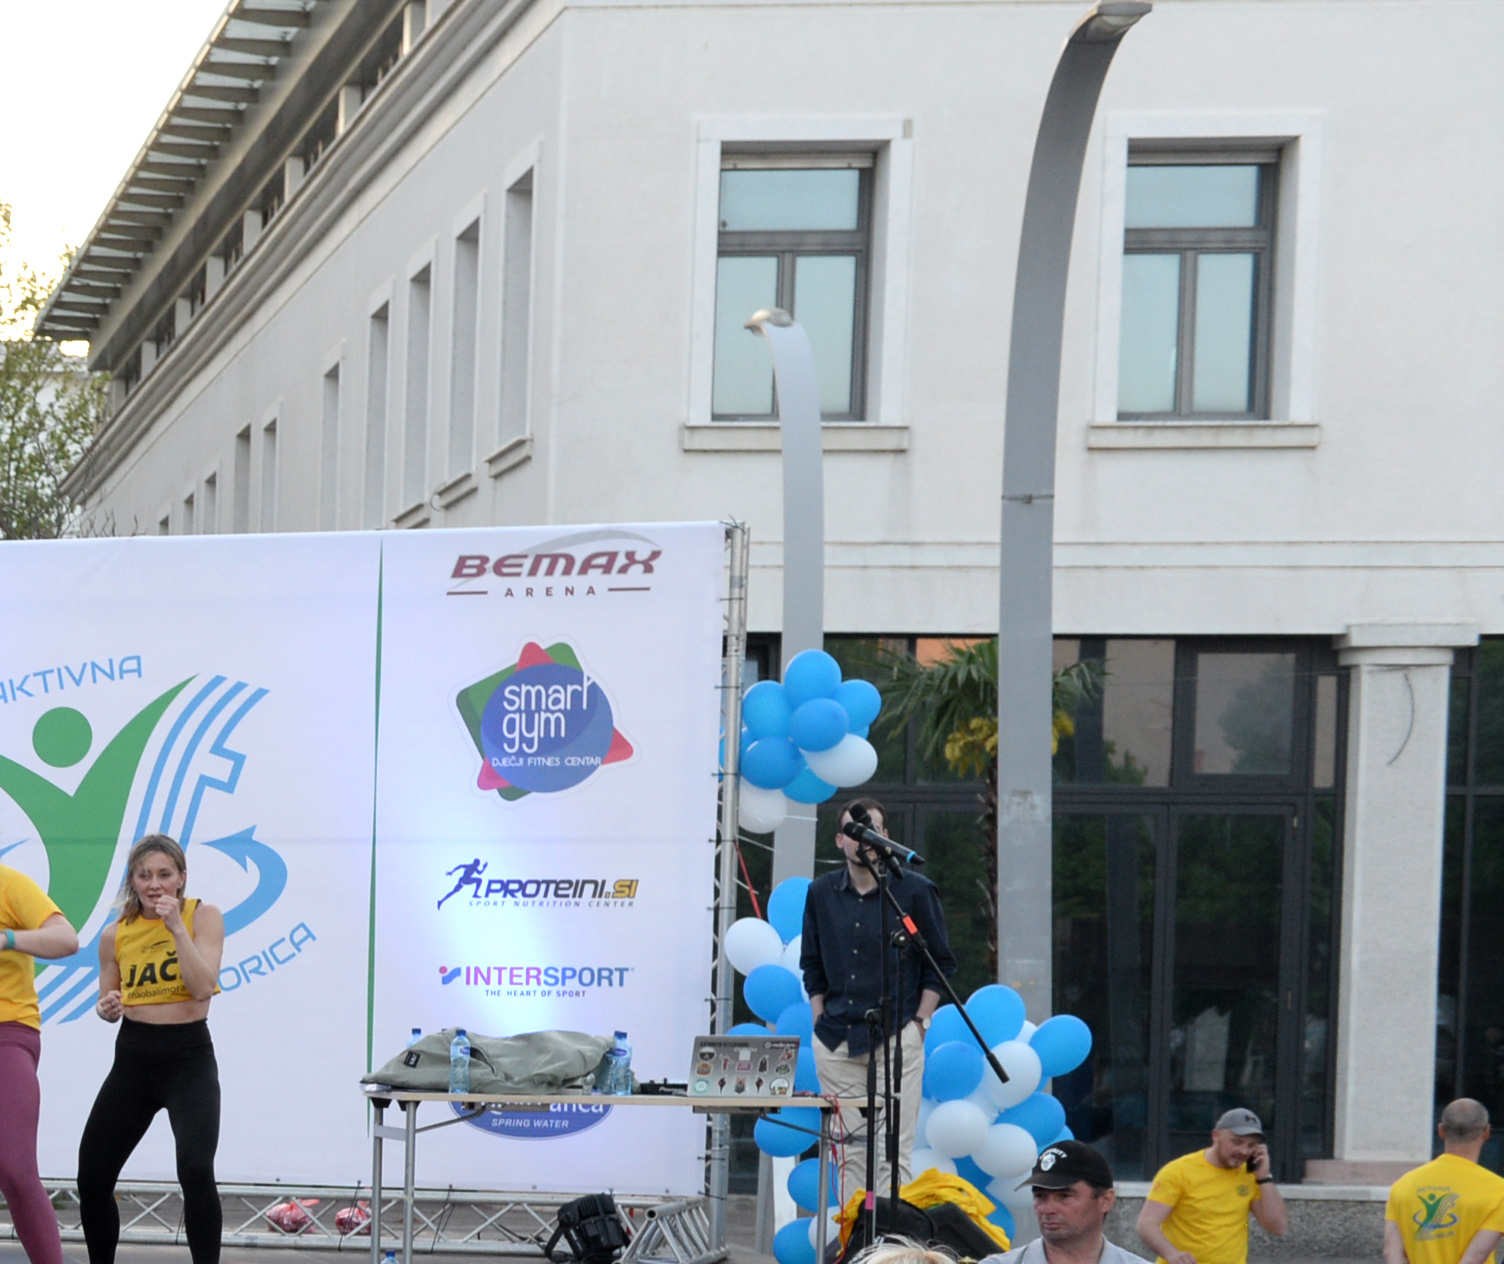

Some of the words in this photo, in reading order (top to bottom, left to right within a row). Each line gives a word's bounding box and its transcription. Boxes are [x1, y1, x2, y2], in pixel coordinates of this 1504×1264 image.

[450, 550, 663, 579] BEMAX
[504, 586, 596, 598] ARENA
[503, 671, 594, 711] smart
[502, 710, 566, 754] gym
[491, 755, 524, 767] DJEČJI
[527, 756, 561, 767] FITNES
[564, 756, 603, 767] CENTAR
[217, 922, 317, 992] ORICA
[465, 966, 630, 987] INTERSPORT
[556, 990, 587, 998] SPORT
[491, 1118, 531, 1128] SPRING
[533, 1119, 570, 1129] WATER
